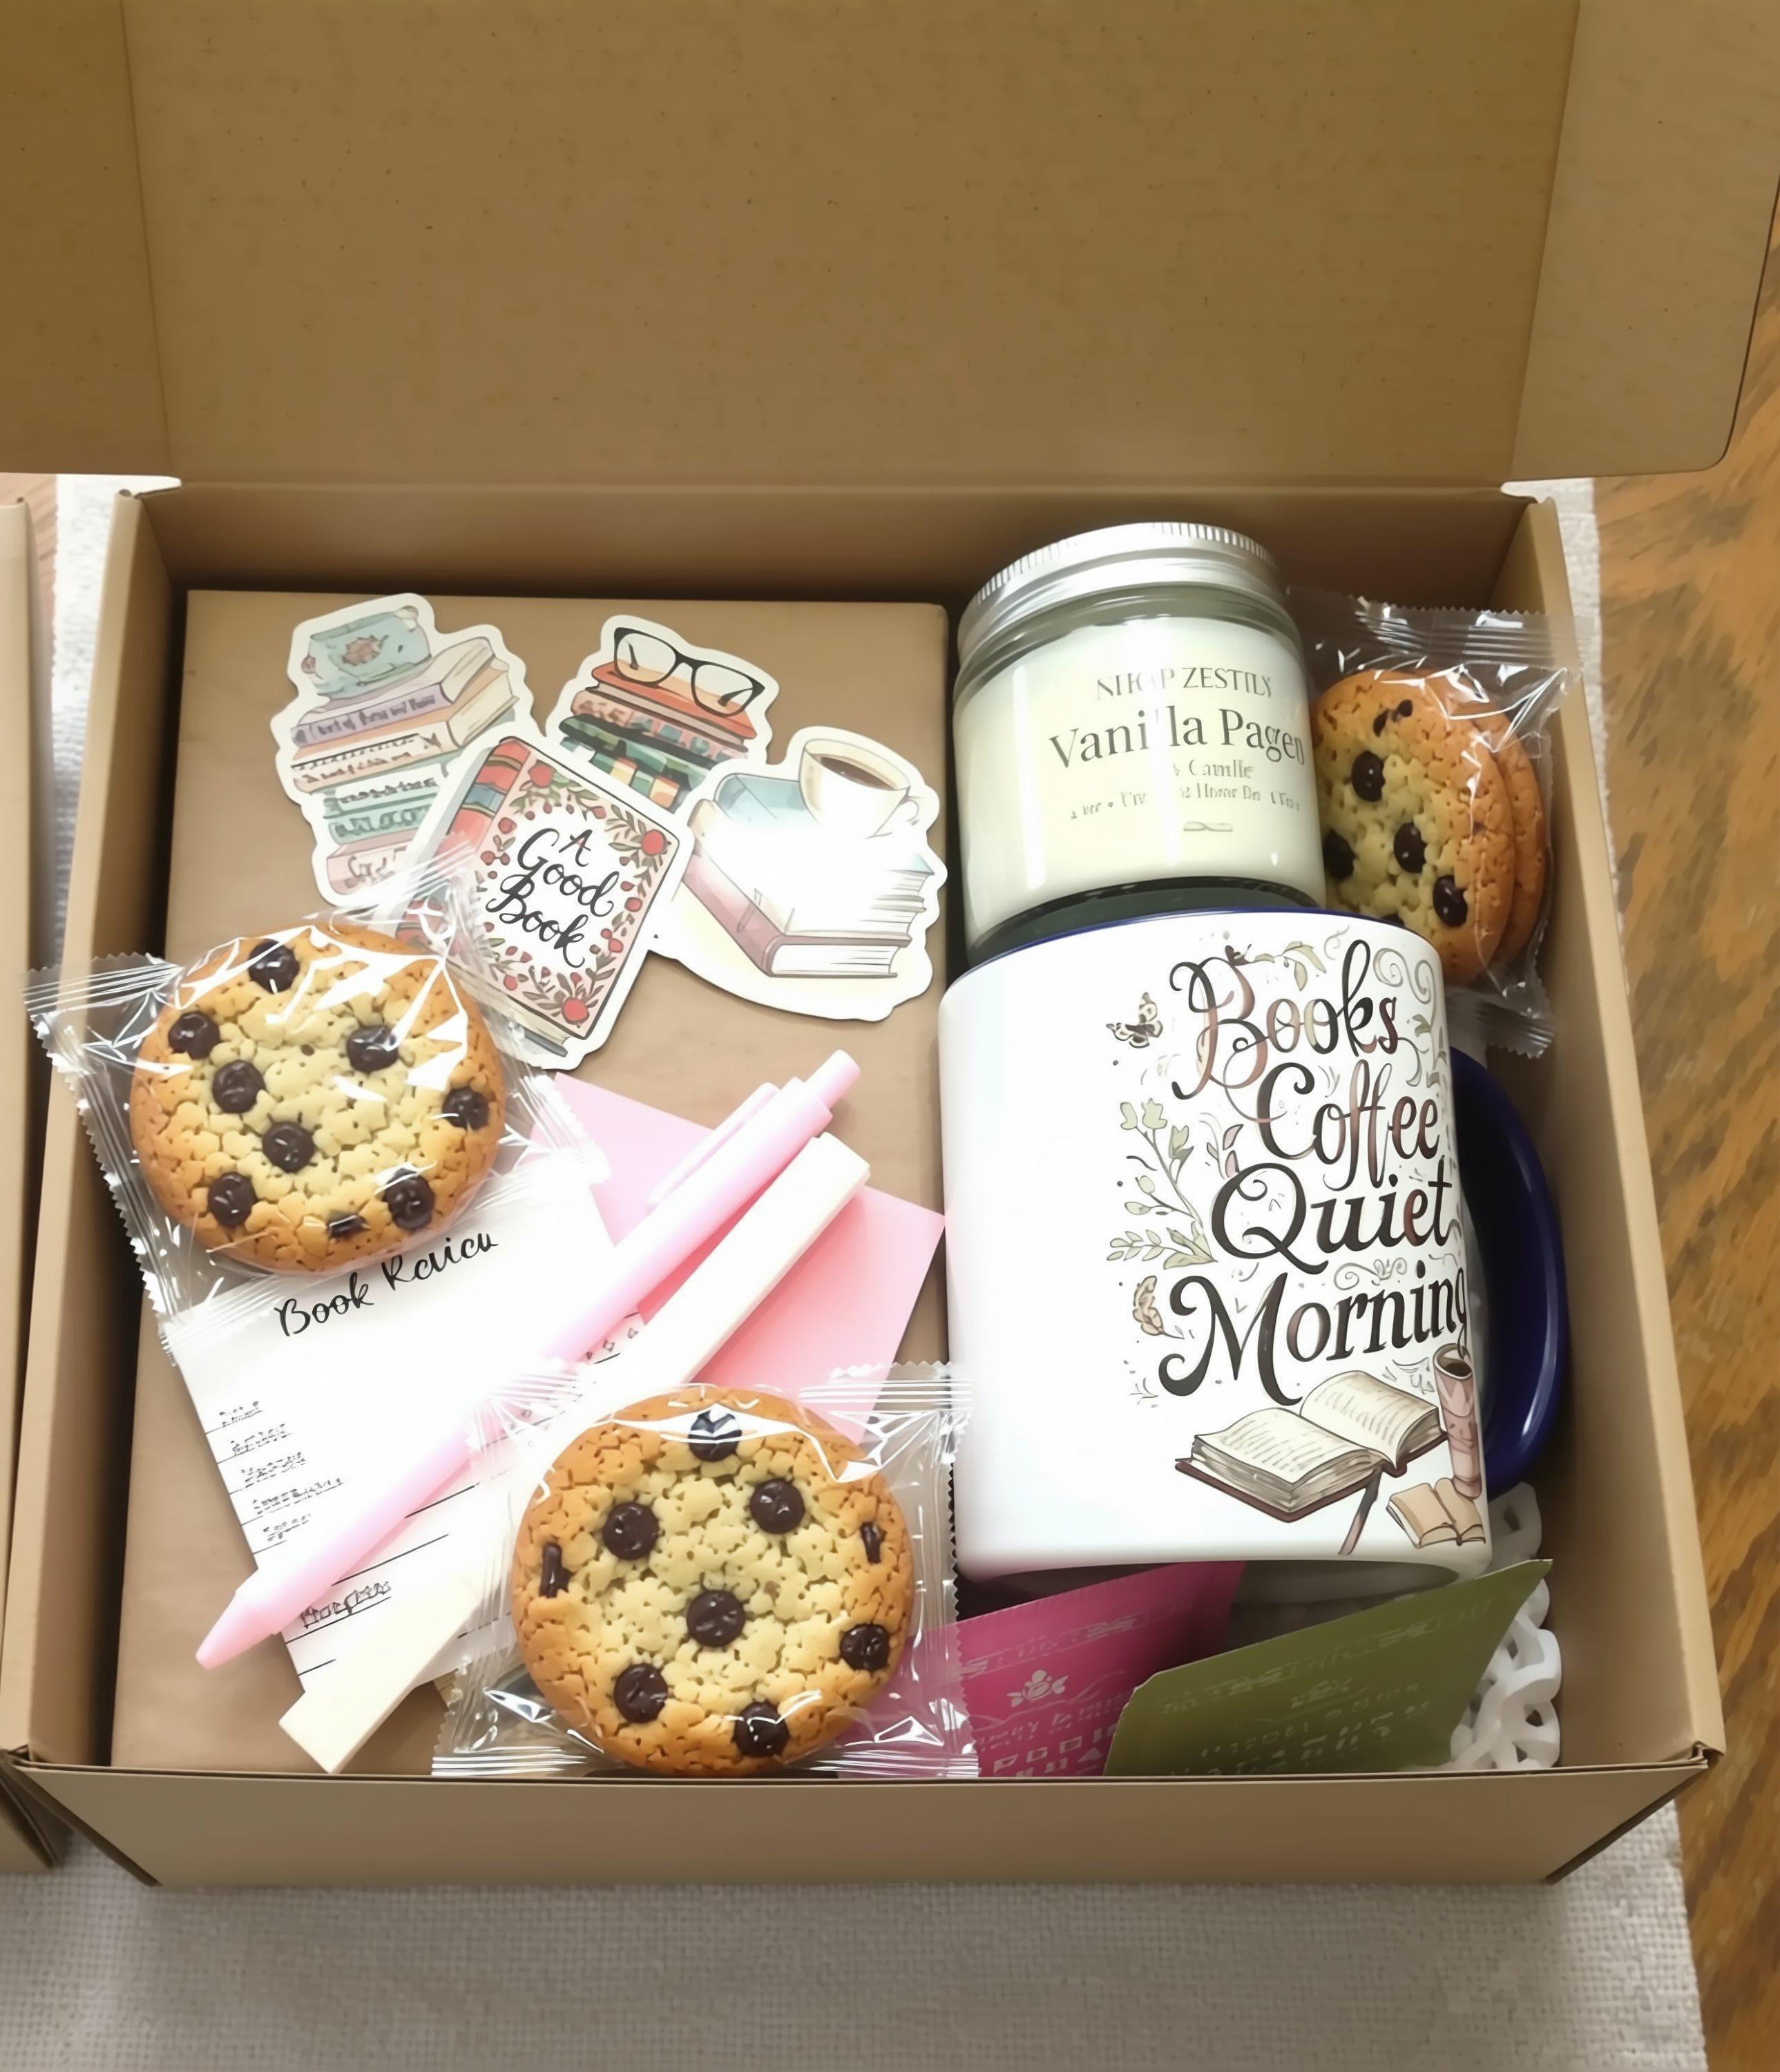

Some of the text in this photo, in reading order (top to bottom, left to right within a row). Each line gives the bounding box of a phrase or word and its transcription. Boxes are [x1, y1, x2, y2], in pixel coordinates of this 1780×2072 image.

[517, 827, 620, 917] Good
[558, 828, 592, 867] A
[485, 873, 589, 968] Book
[1169, 939, 1400, 1100] Books
[1255, 1059, 1440, 1191] Coffee
[1210, 1155, 1453, 1275] Quiet
[274, 1272, 375, 1337] Book
[1158, 1259, 1469, 1406] Morning
